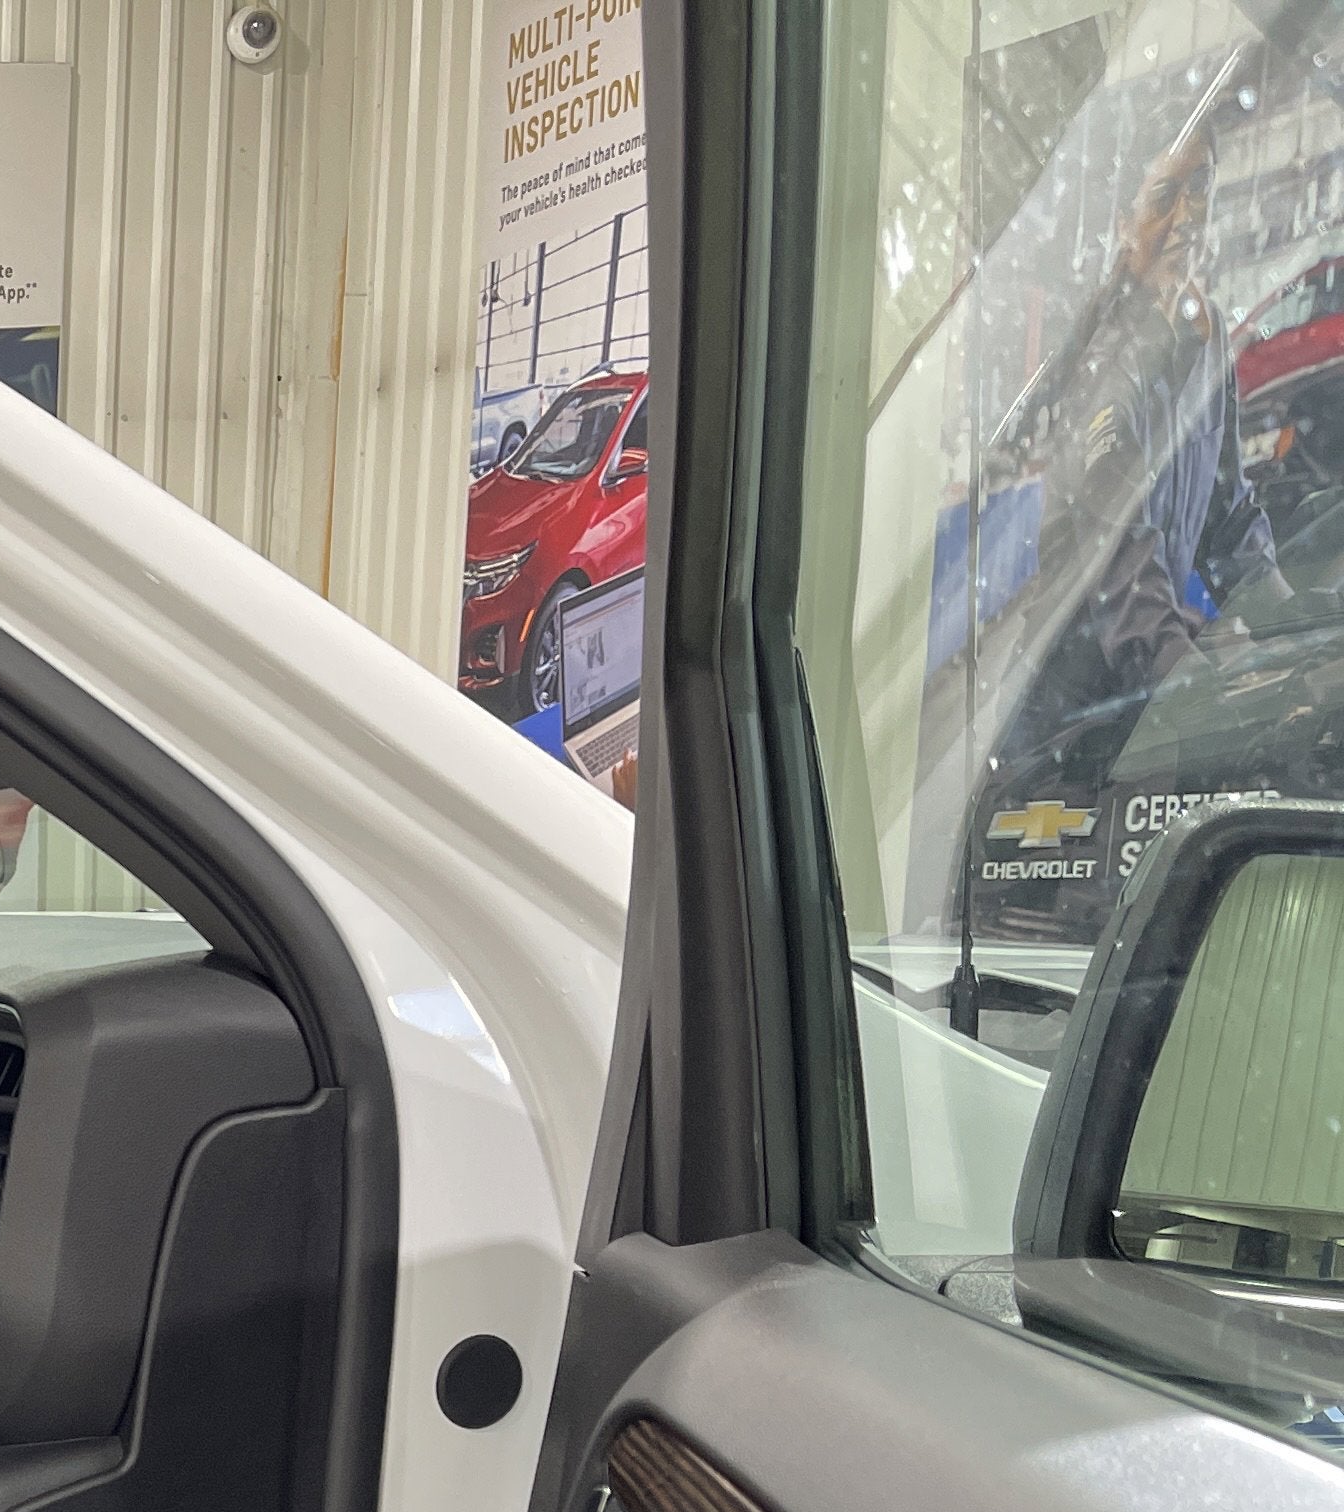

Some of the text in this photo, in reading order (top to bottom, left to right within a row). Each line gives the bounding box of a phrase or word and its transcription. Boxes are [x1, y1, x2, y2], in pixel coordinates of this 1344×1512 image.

[506, 39, 602, 115] VEHICLE
[503, 70, 641, 163] INSPECTION
[498, 206, 522, 232] your
[524, 187, 566, 217] vehicle's
[568, 172, 601, 200] health
[501, 184, 519, 203] The
[520, 172, 550, 200] peace
[552, 162, 564, 182] of
[565, 151, 591, 177] mind
[593, 143, 616, 166] that
[982, 859, 1098, 881] CHEVROLET
